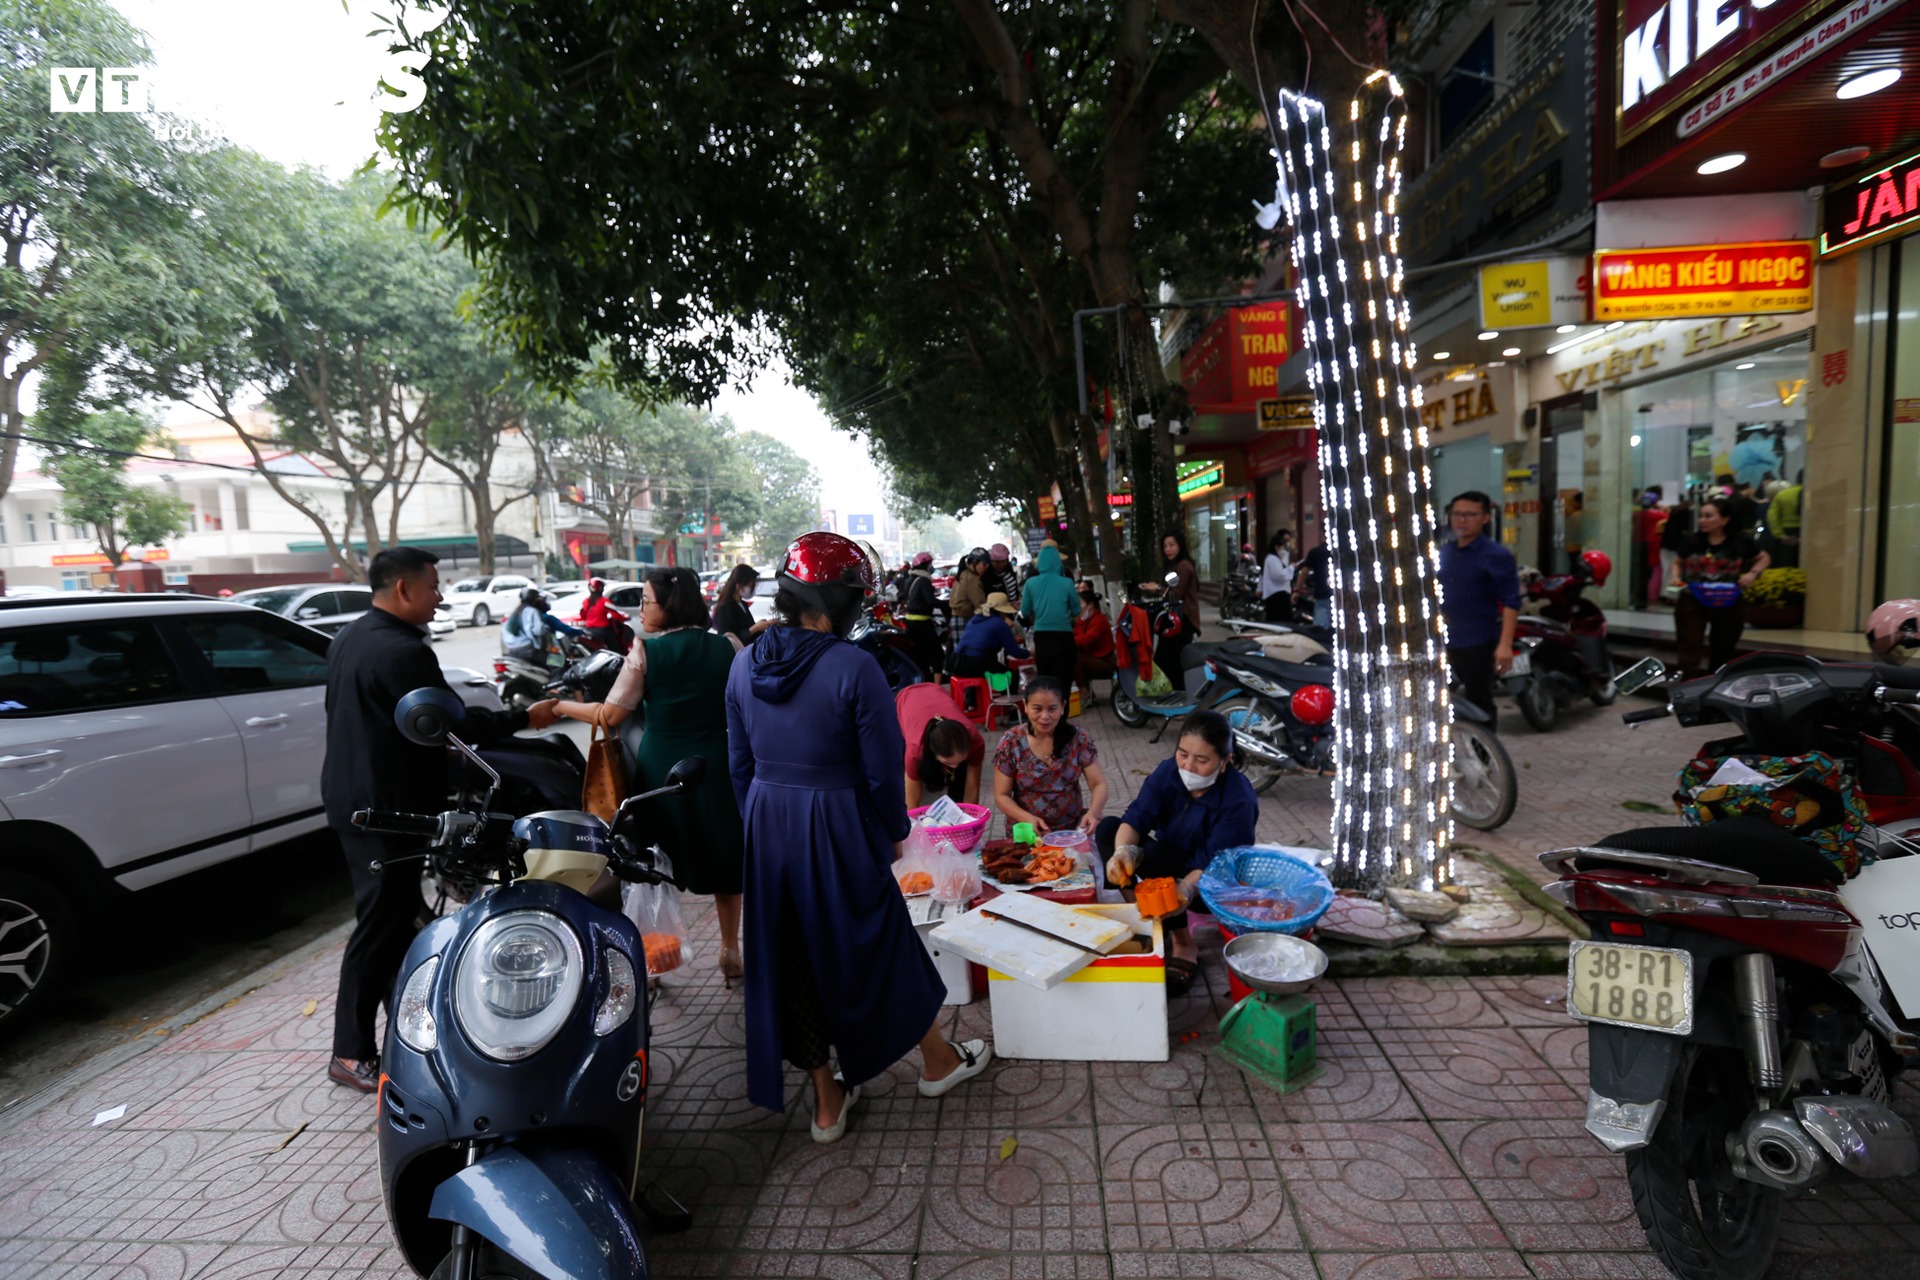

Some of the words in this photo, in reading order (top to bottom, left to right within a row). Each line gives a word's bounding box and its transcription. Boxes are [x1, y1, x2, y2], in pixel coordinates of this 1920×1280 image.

[1727, 87, 1736, 104] 2
[1605, 259, 1671, 290] VÀNG
[1739, 256, 1806, 287] NGỌC
[1248, 365, 1279, 387] NG
[576, 834, 604, 846] HONDA
[1588, 947, 1672, 989] 38-R1
[1588, 981, 1674, 1026] 1888
